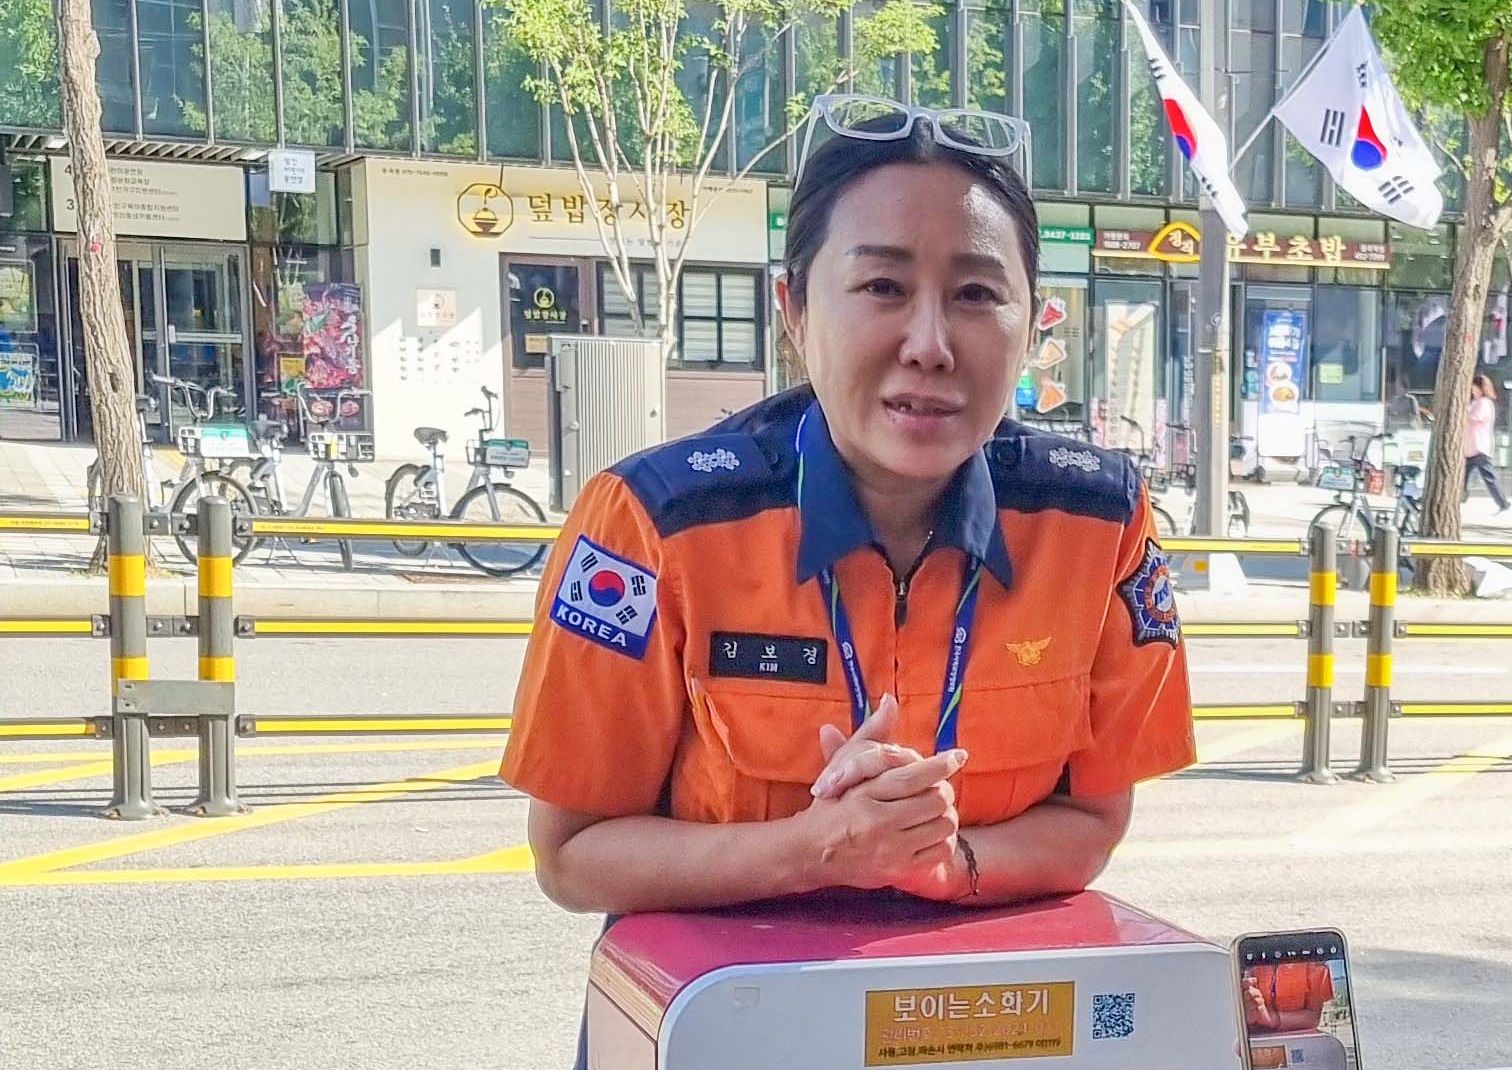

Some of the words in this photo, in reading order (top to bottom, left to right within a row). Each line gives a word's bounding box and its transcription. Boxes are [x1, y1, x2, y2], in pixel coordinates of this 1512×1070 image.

[66, 199, 75, 210] 3
[1226, 231, 1346, 263] 유부초밥
[555, 603, 628, 648] KOREA
[759, 662, 778, 673] KIM
[893, 988, 1049, 1023] 보이는소화기
